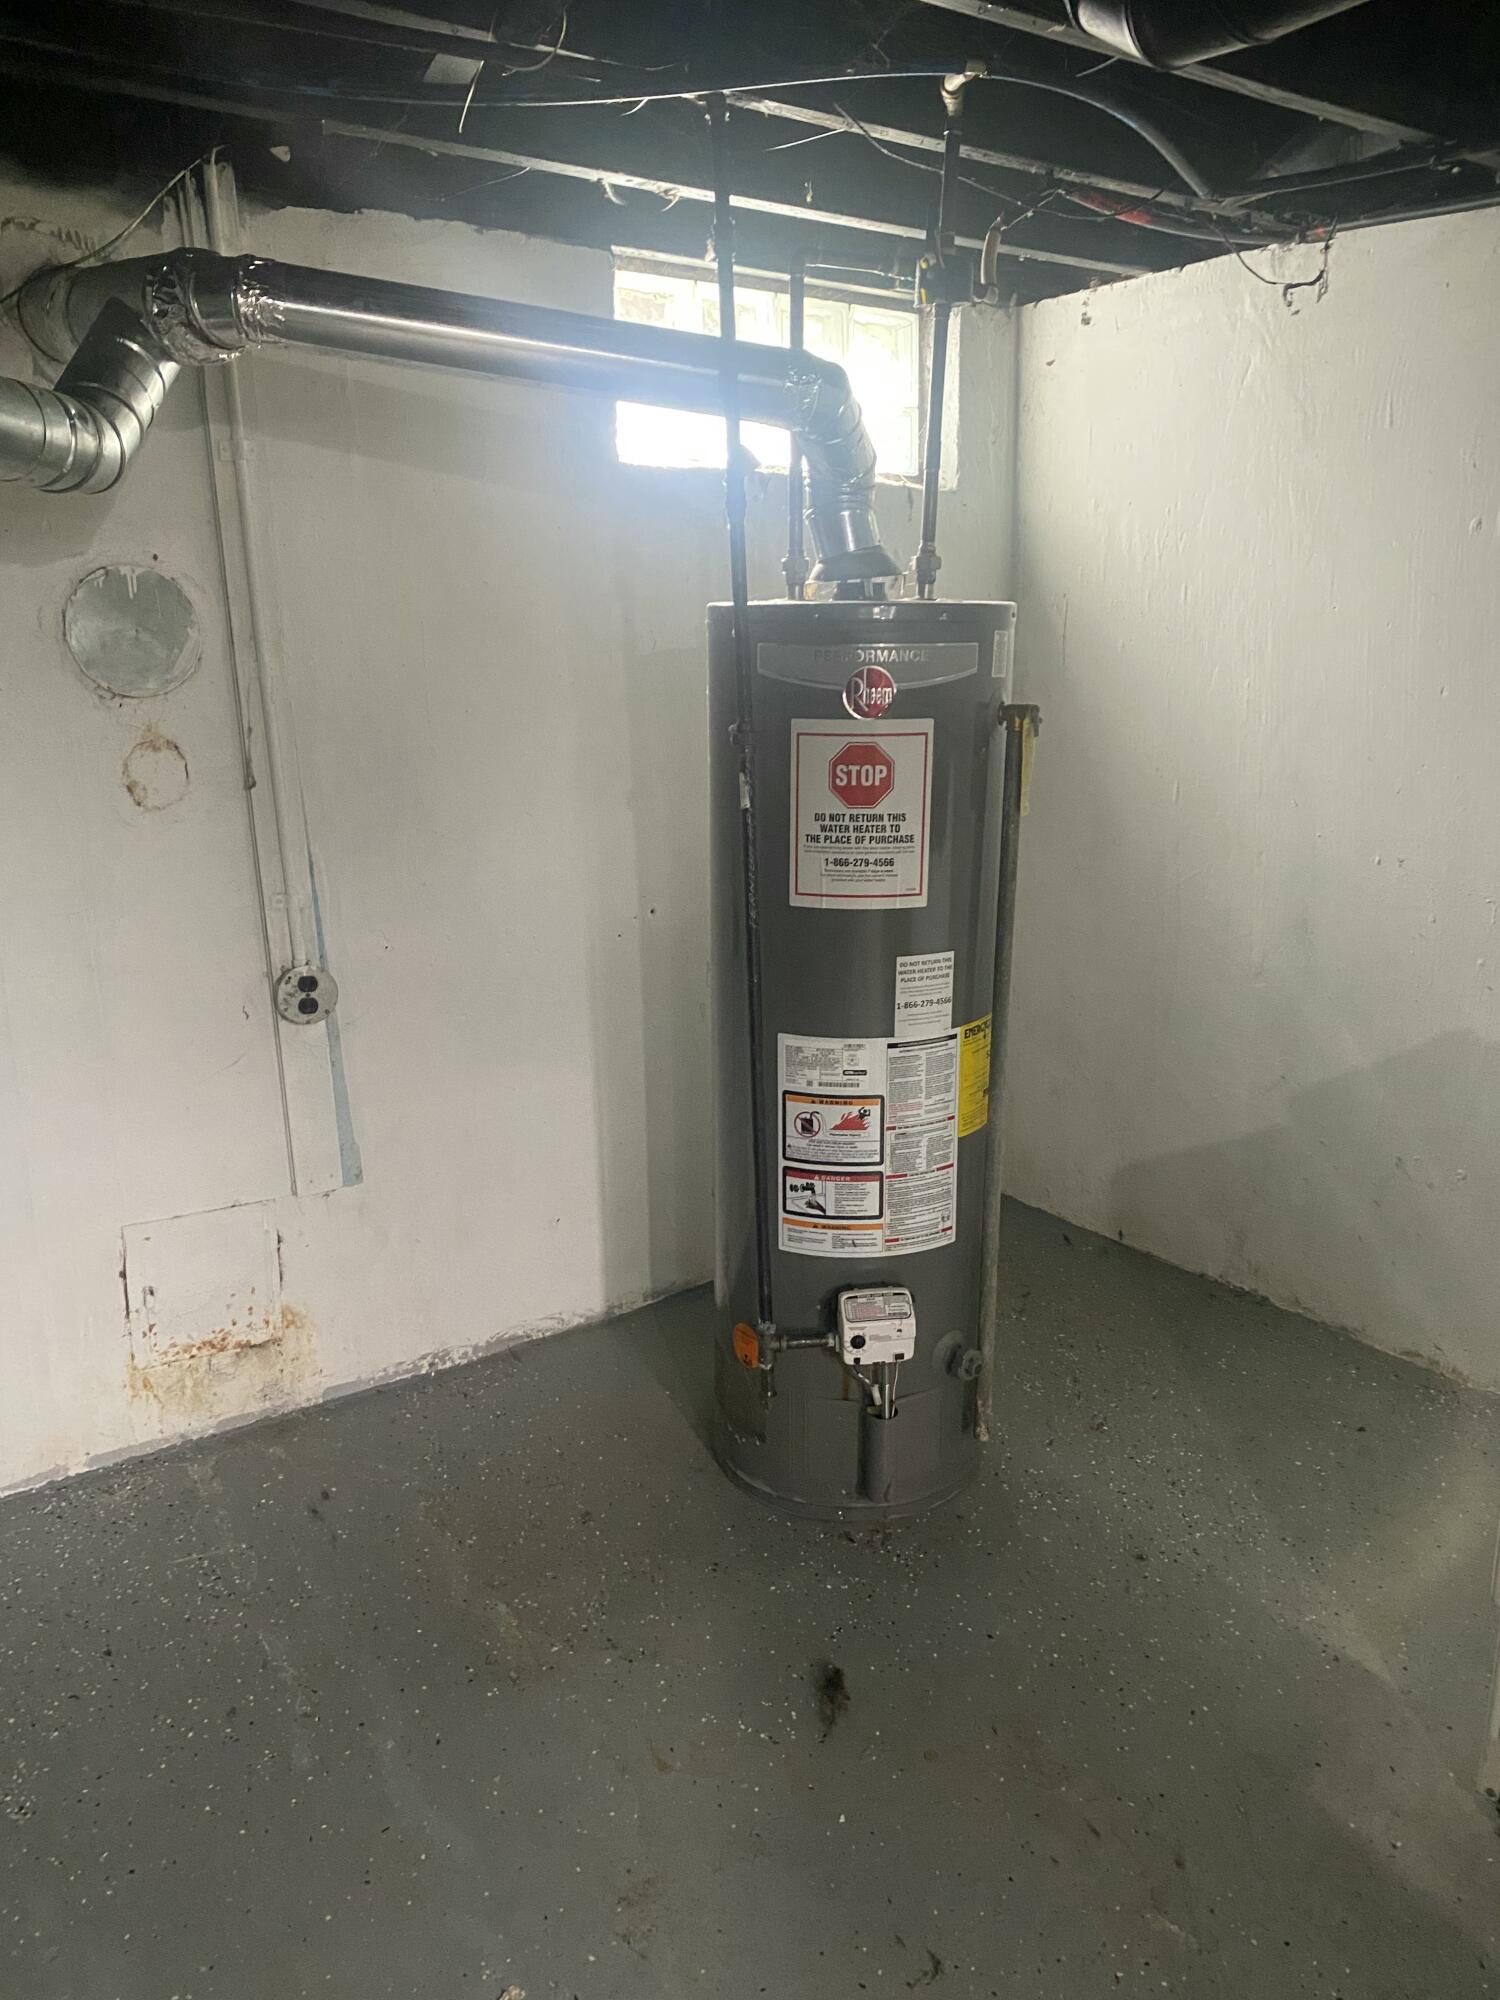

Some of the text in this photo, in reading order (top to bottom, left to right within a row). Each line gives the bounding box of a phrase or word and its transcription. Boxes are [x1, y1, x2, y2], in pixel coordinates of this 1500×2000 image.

[814, 649, 929, 663] PEORMANCE
[849, 667, 892, 711] Rheem
[835, 764, 888, 786] STOP
[814, 813, 906, 823] DO NOT RETURN THIS
[819, 824, 901, 833] WATER HEATER TO
[804, 834, 915, 844] THE PLACE OF PURCHASE
[823, 857, 895, 867] 1-866-279-4566
[821, 1174, 851, 1182] DANGER
